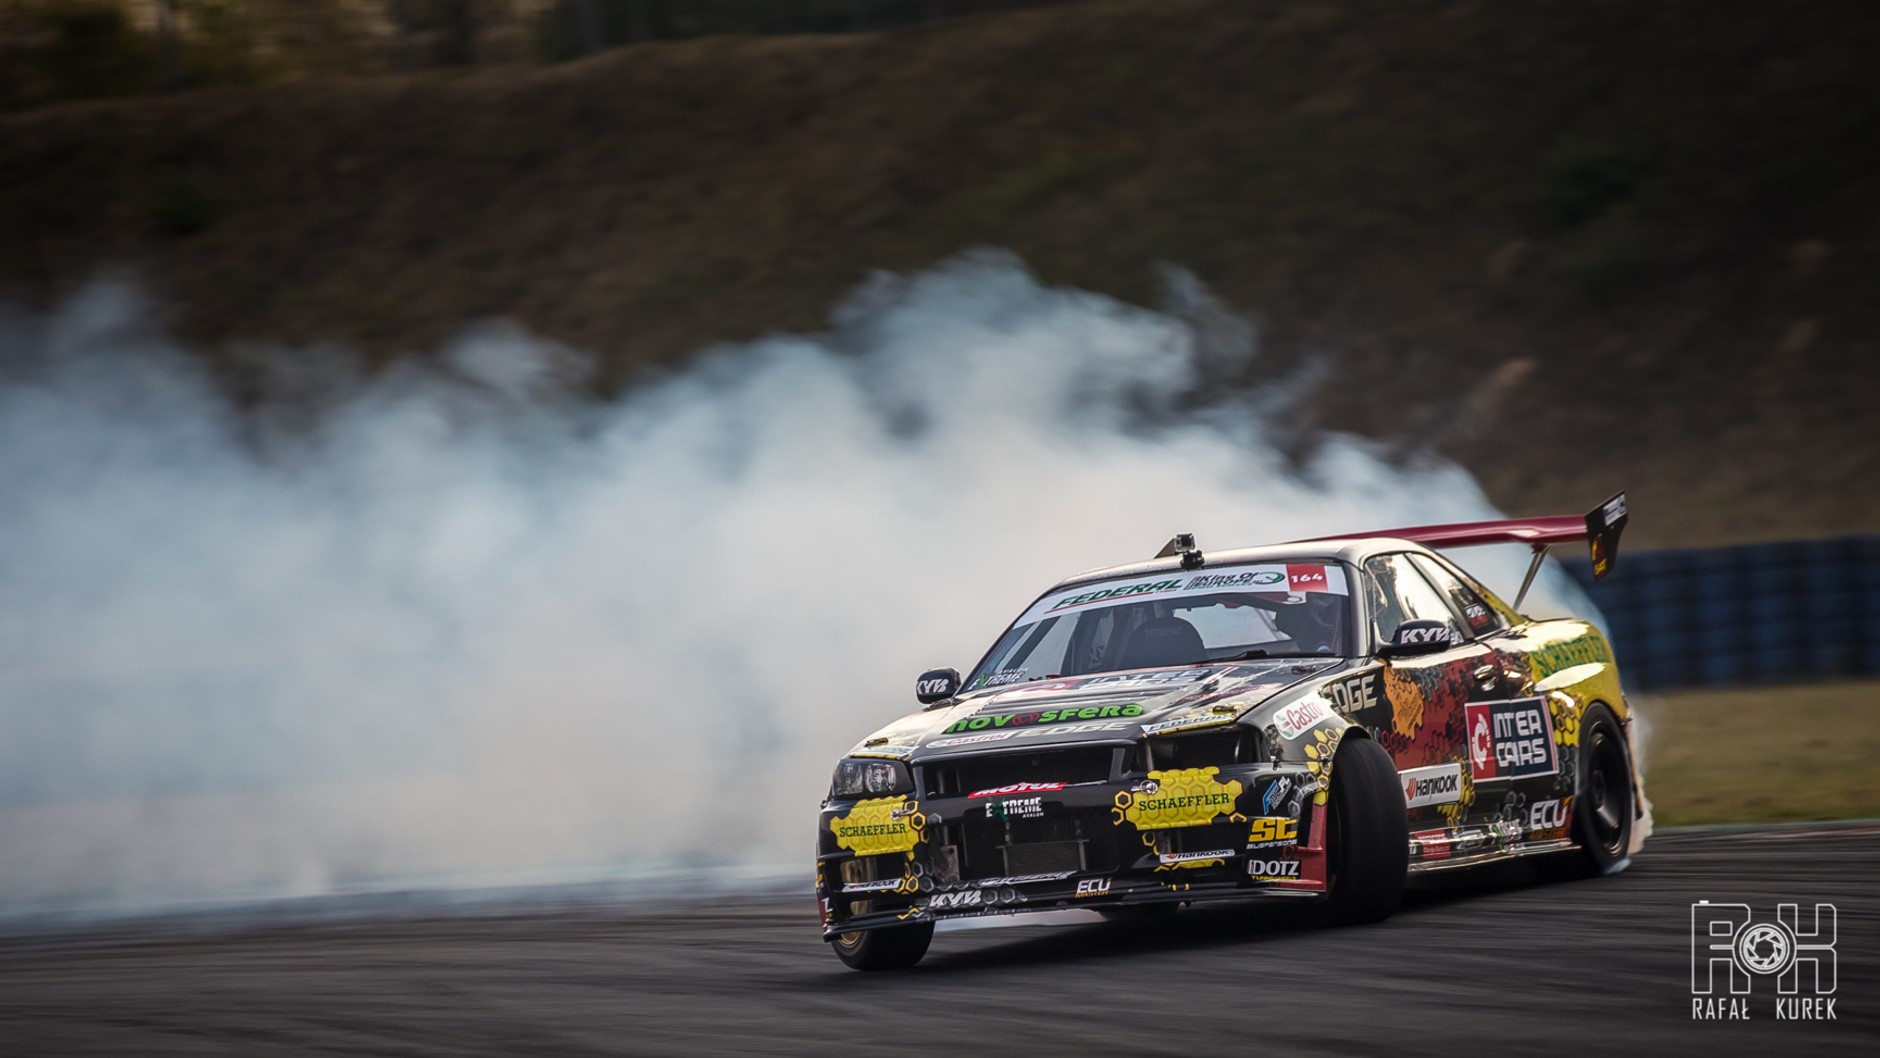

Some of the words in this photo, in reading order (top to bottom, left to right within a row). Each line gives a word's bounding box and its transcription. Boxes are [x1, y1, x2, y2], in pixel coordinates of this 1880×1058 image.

[1290, 573, 1324, 583] 164
[1052, 579, 1184, 609] FEDERAL
[1493, 709, 1543, 739] INTER
[1496, 738, 1547, 768] CARS
[974, 782, 1065, 797] MOTUL
[985, 796, 1042, 824] EXTREME
[1139, 793, 1230, 811] SCHAEFFLER
[1531, 799, 1569, 831] ECU
[839, 823, 907, 838] SCHAEFFLER
[1248, 860, 1300, 876] DOTZ
[1077, 878, 1111, 894] ECU
[930, 890, 981, 907] KYB
